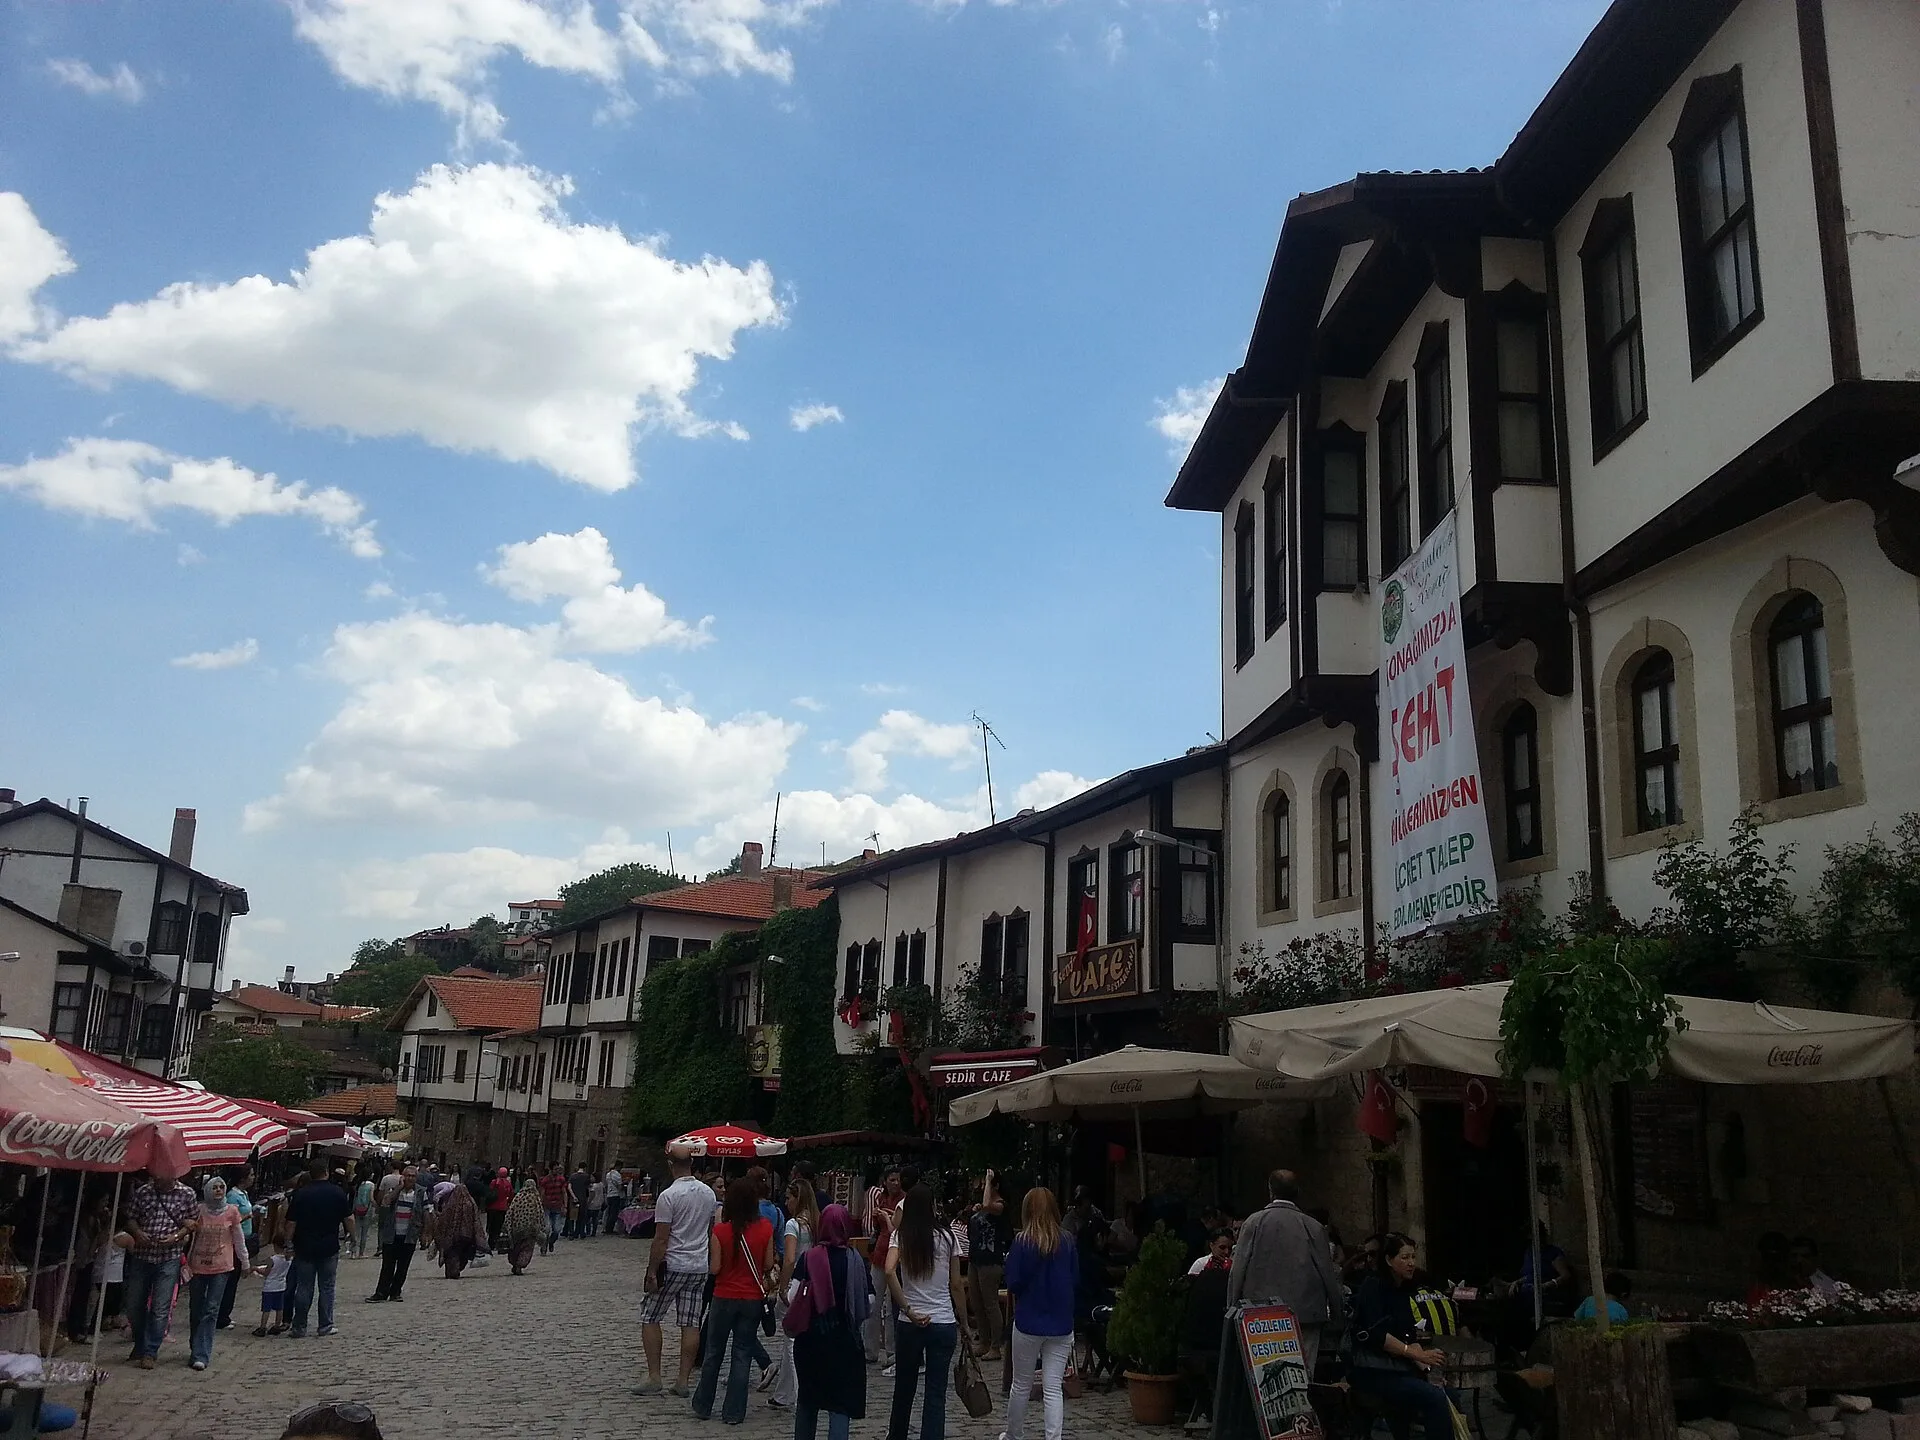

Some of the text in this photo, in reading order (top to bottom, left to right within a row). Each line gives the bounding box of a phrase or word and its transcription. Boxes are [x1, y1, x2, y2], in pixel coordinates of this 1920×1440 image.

[1426, 832, 1475, 875] TALEP
[945, 1069, 1012, 1084] SEDİR CAFE
[0, 1111, 139, 1164] Coca-Cola
[1247, 1317, 1292, 1334] GÖZLEME
[1251, 1337, 1299, 1360] ÇEŞİTLERİ
